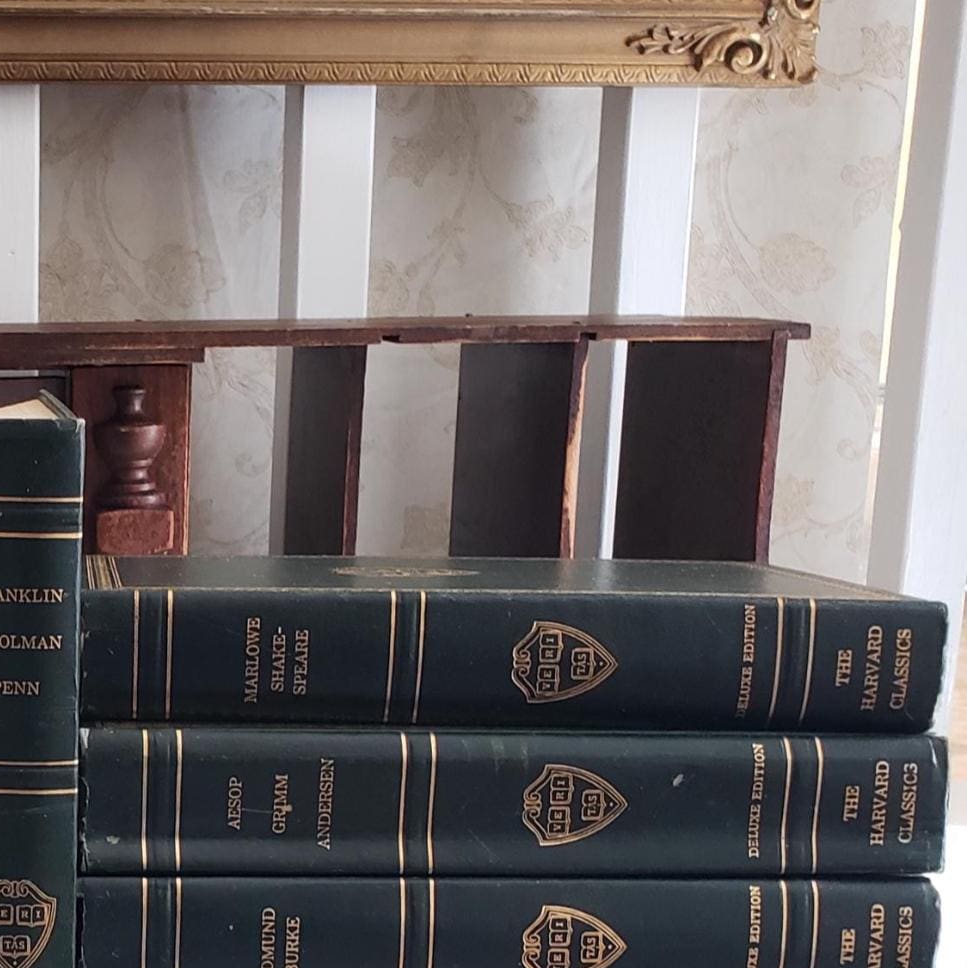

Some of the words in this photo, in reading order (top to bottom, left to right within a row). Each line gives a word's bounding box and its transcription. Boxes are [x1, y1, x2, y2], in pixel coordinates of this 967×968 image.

[244, 617, 261, 703] MARLOWE
[270, 626, 286, 692] SHAKE-
[292, 629, 309, 696] SPEARE
[743, 604, 757, 663] EDITION
[734, 667, 753, 720] DELUXE
[836, 649, 853, 687] THE
[861, 625, 883, 711] HARVARD
[889, 628, 912, 710] CLASSICS
[751, 743, 766, 801] EDITION
[227, 776, 243, 830] AESOP
[271, 774, 289, 834] GRIMM
[317, 758, 335, 850] ANDERSEN
[748, 804, 761, 858] DELUXE
[843, 785, 860, 822] THE
[870, 760, 889, 846] HARVARD
[749, 886, 761, 942] EDITION
[840, 928, 856, 965] THE
